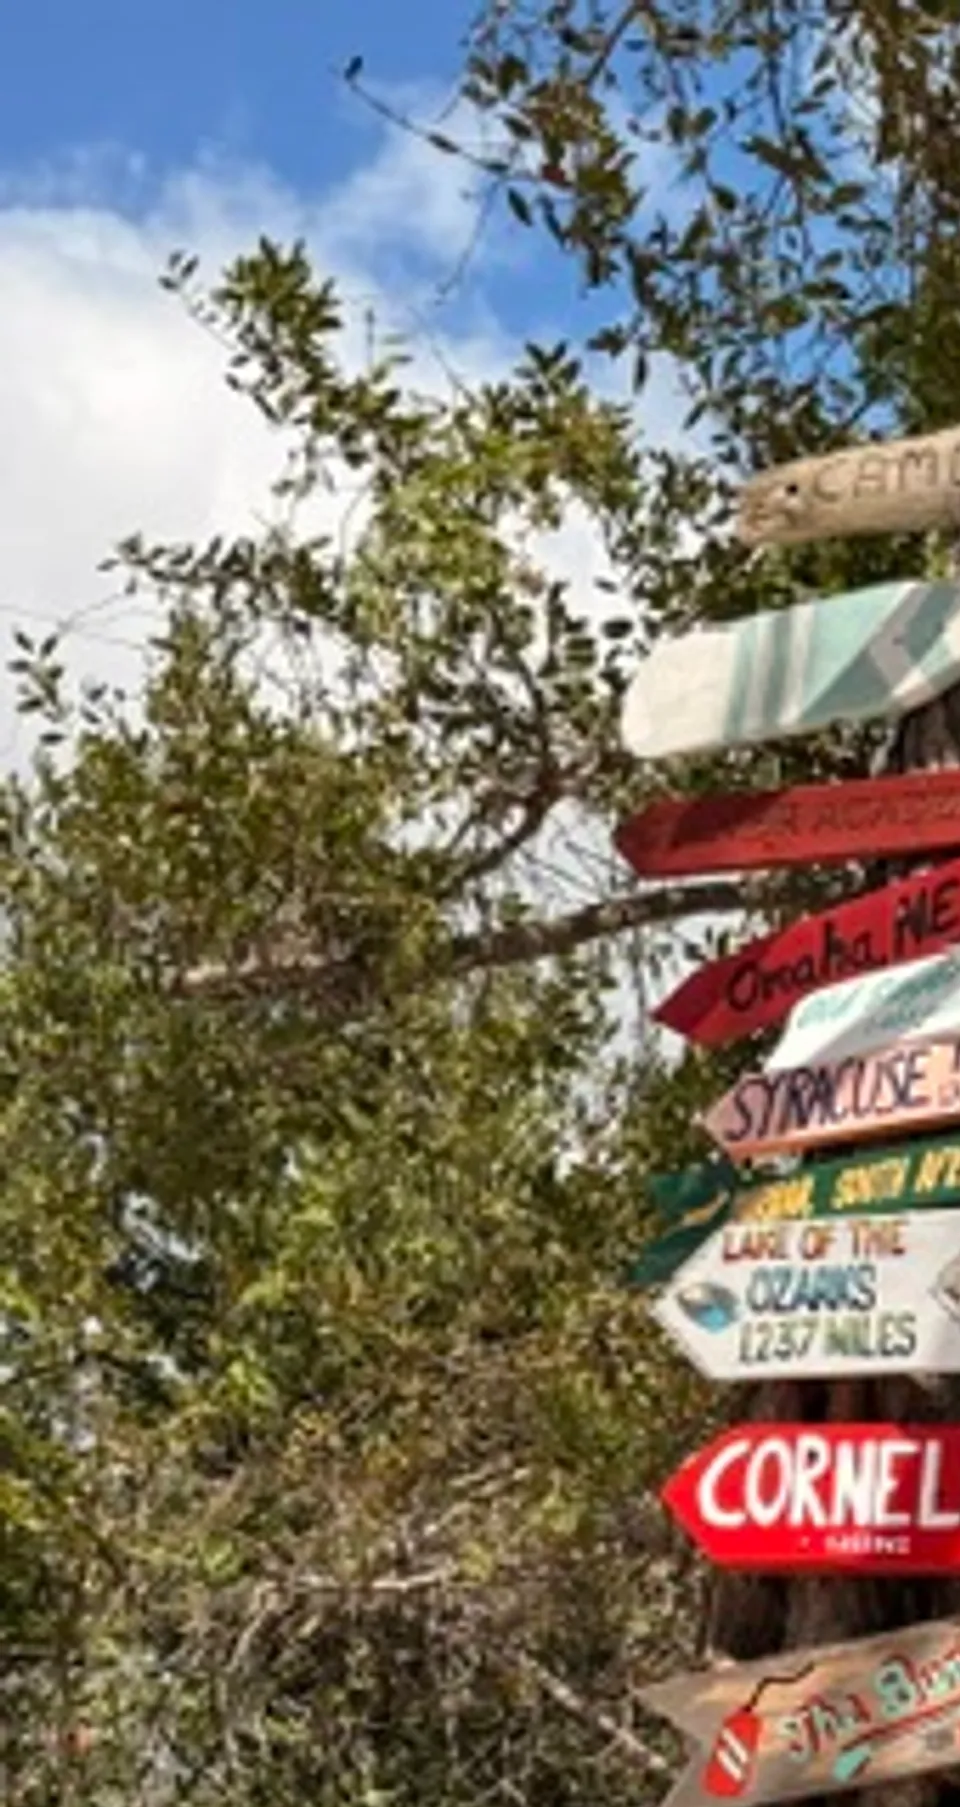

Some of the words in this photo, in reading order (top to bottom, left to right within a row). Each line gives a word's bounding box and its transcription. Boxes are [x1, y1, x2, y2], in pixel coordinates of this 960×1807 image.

[727, 1048, 933, 1142] SYRACUSE
[721, 1222, 787, 1262] LAKE
[799, 1221, 838, 1261] OF
[849, 1218, 911, 1258] THE
[746, 1263, 878, 1312] OZARKS
[738, 1317, 817, 1364] 1237
[823, 1313, 918, 1359] MILES
